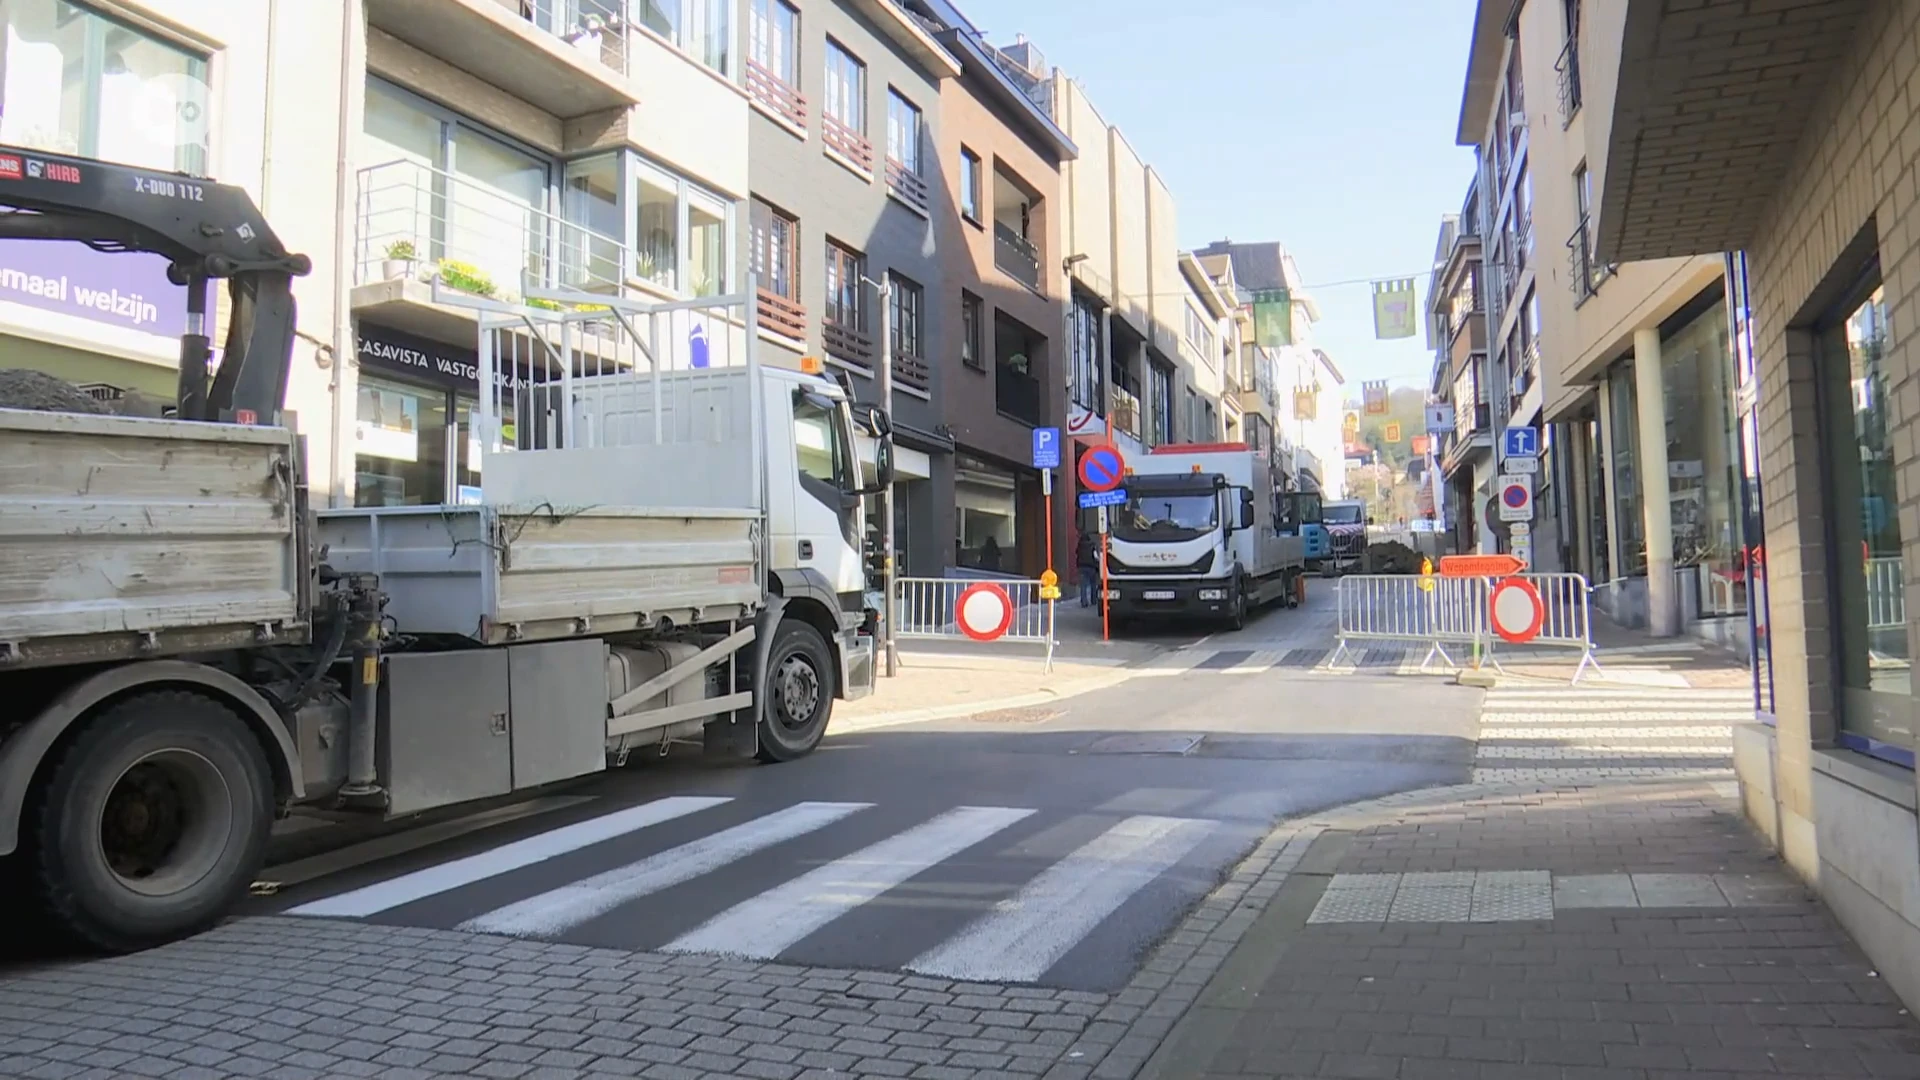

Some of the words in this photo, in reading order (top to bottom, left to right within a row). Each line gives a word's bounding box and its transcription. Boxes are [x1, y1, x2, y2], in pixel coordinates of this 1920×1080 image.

[0, 158, 19, 173] NS
[134, 176, 175, 197] X-DUO
[179, 183, 204, 202] 112
[0, 267, 68, 301] maal
[73, 288, 157, 325] welzijn
[1038, 431, 1052, 450] P
